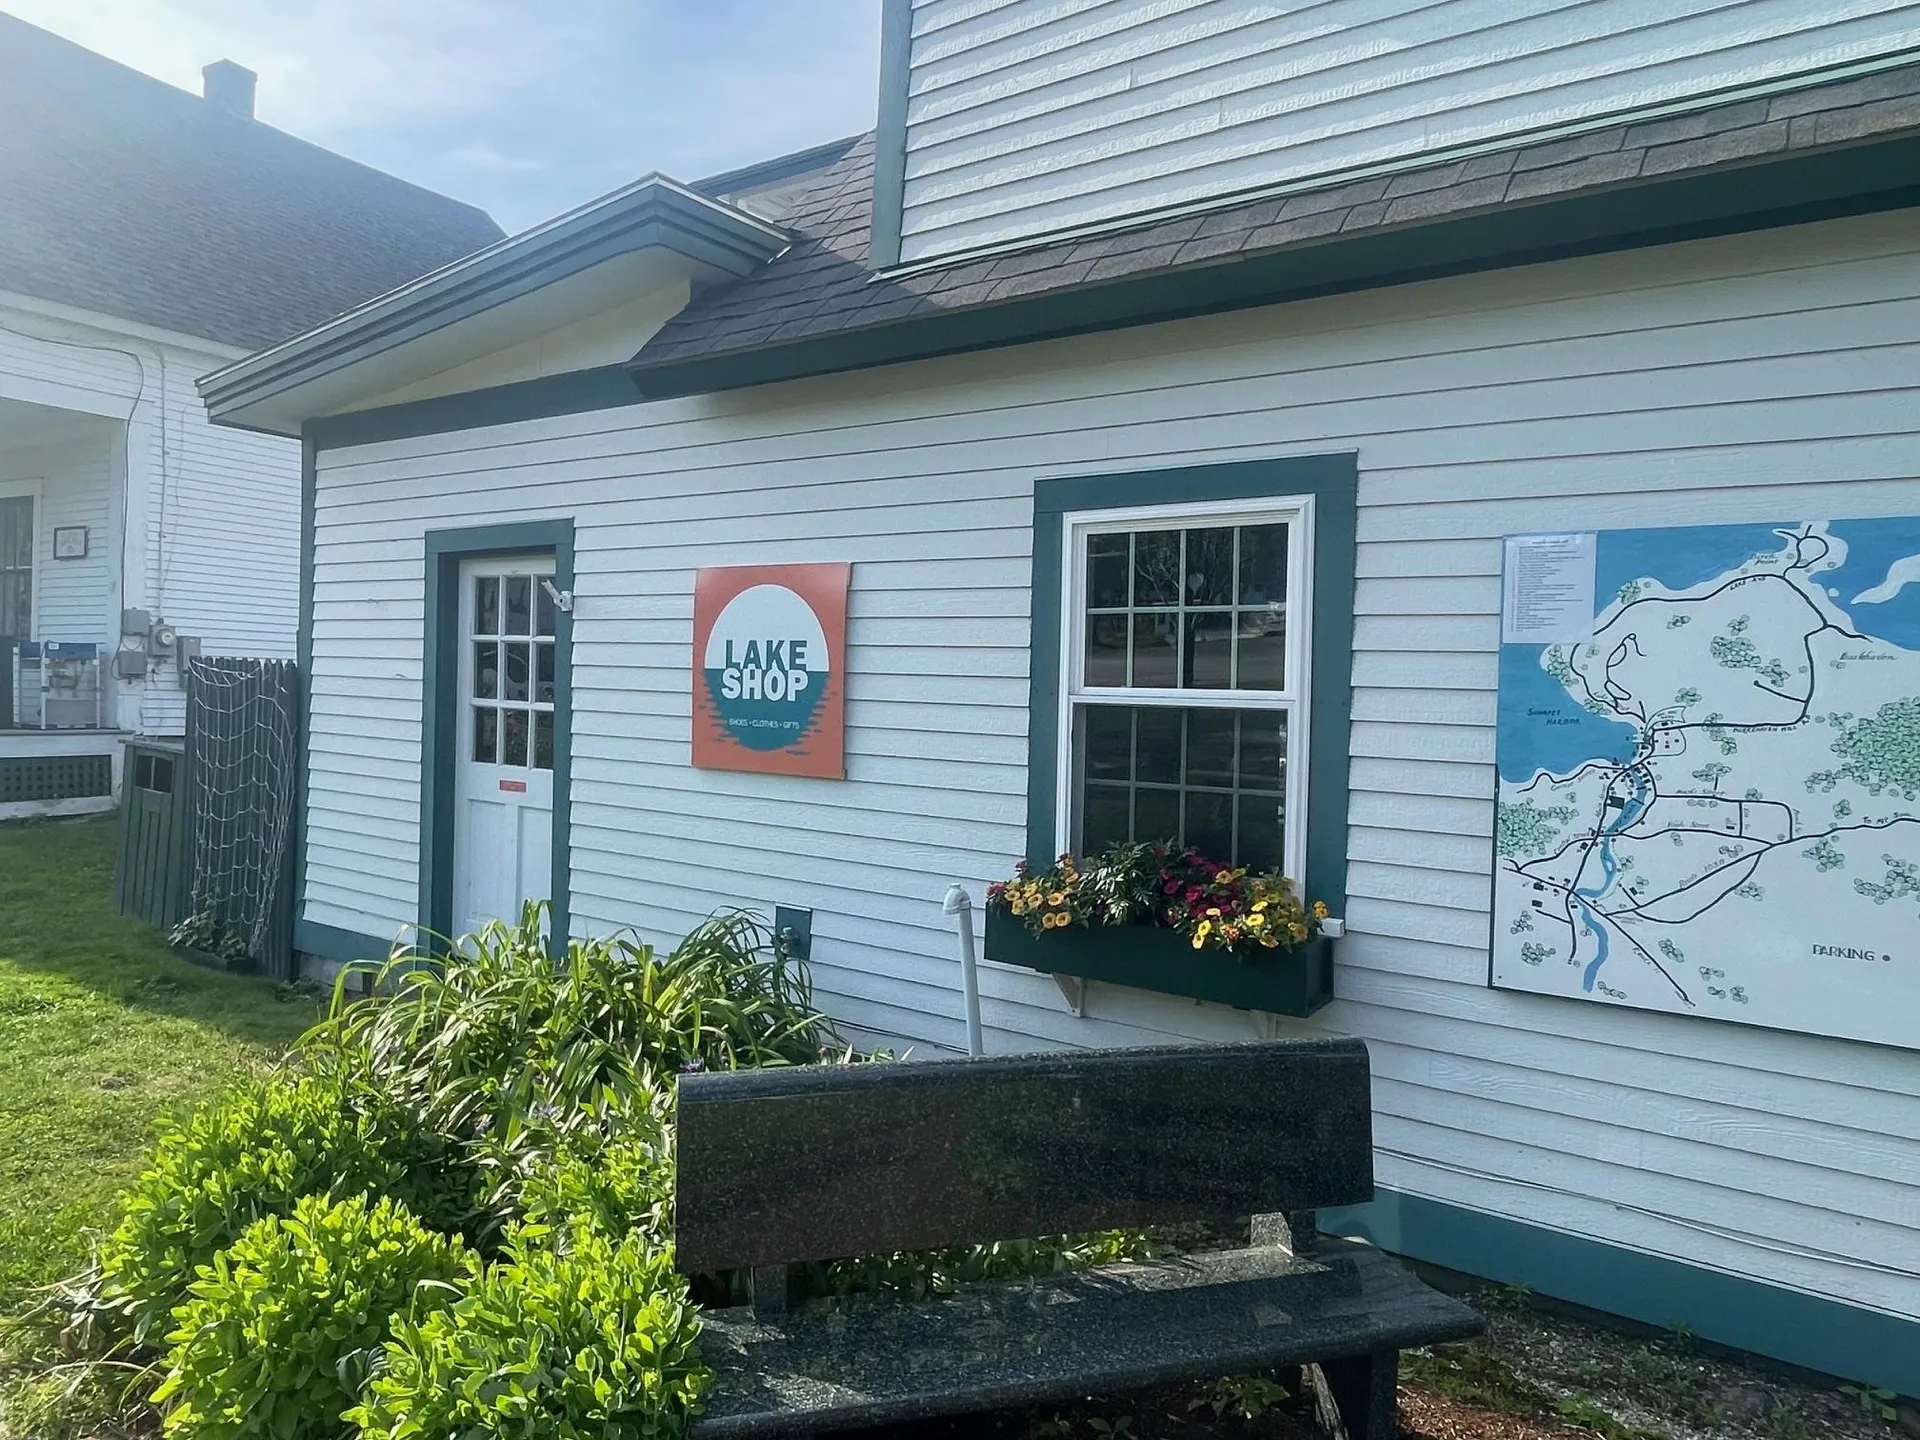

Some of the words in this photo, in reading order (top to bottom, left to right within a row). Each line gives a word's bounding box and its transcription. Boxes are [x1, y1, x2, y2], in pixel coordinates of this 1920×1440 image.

[725, 639, 807, 670] LAKE
[721, 667, 809, 702] SHOP
[752, 719, 779, 729] CLOTHES
[1812, 943, 1876, 962] PARKING
